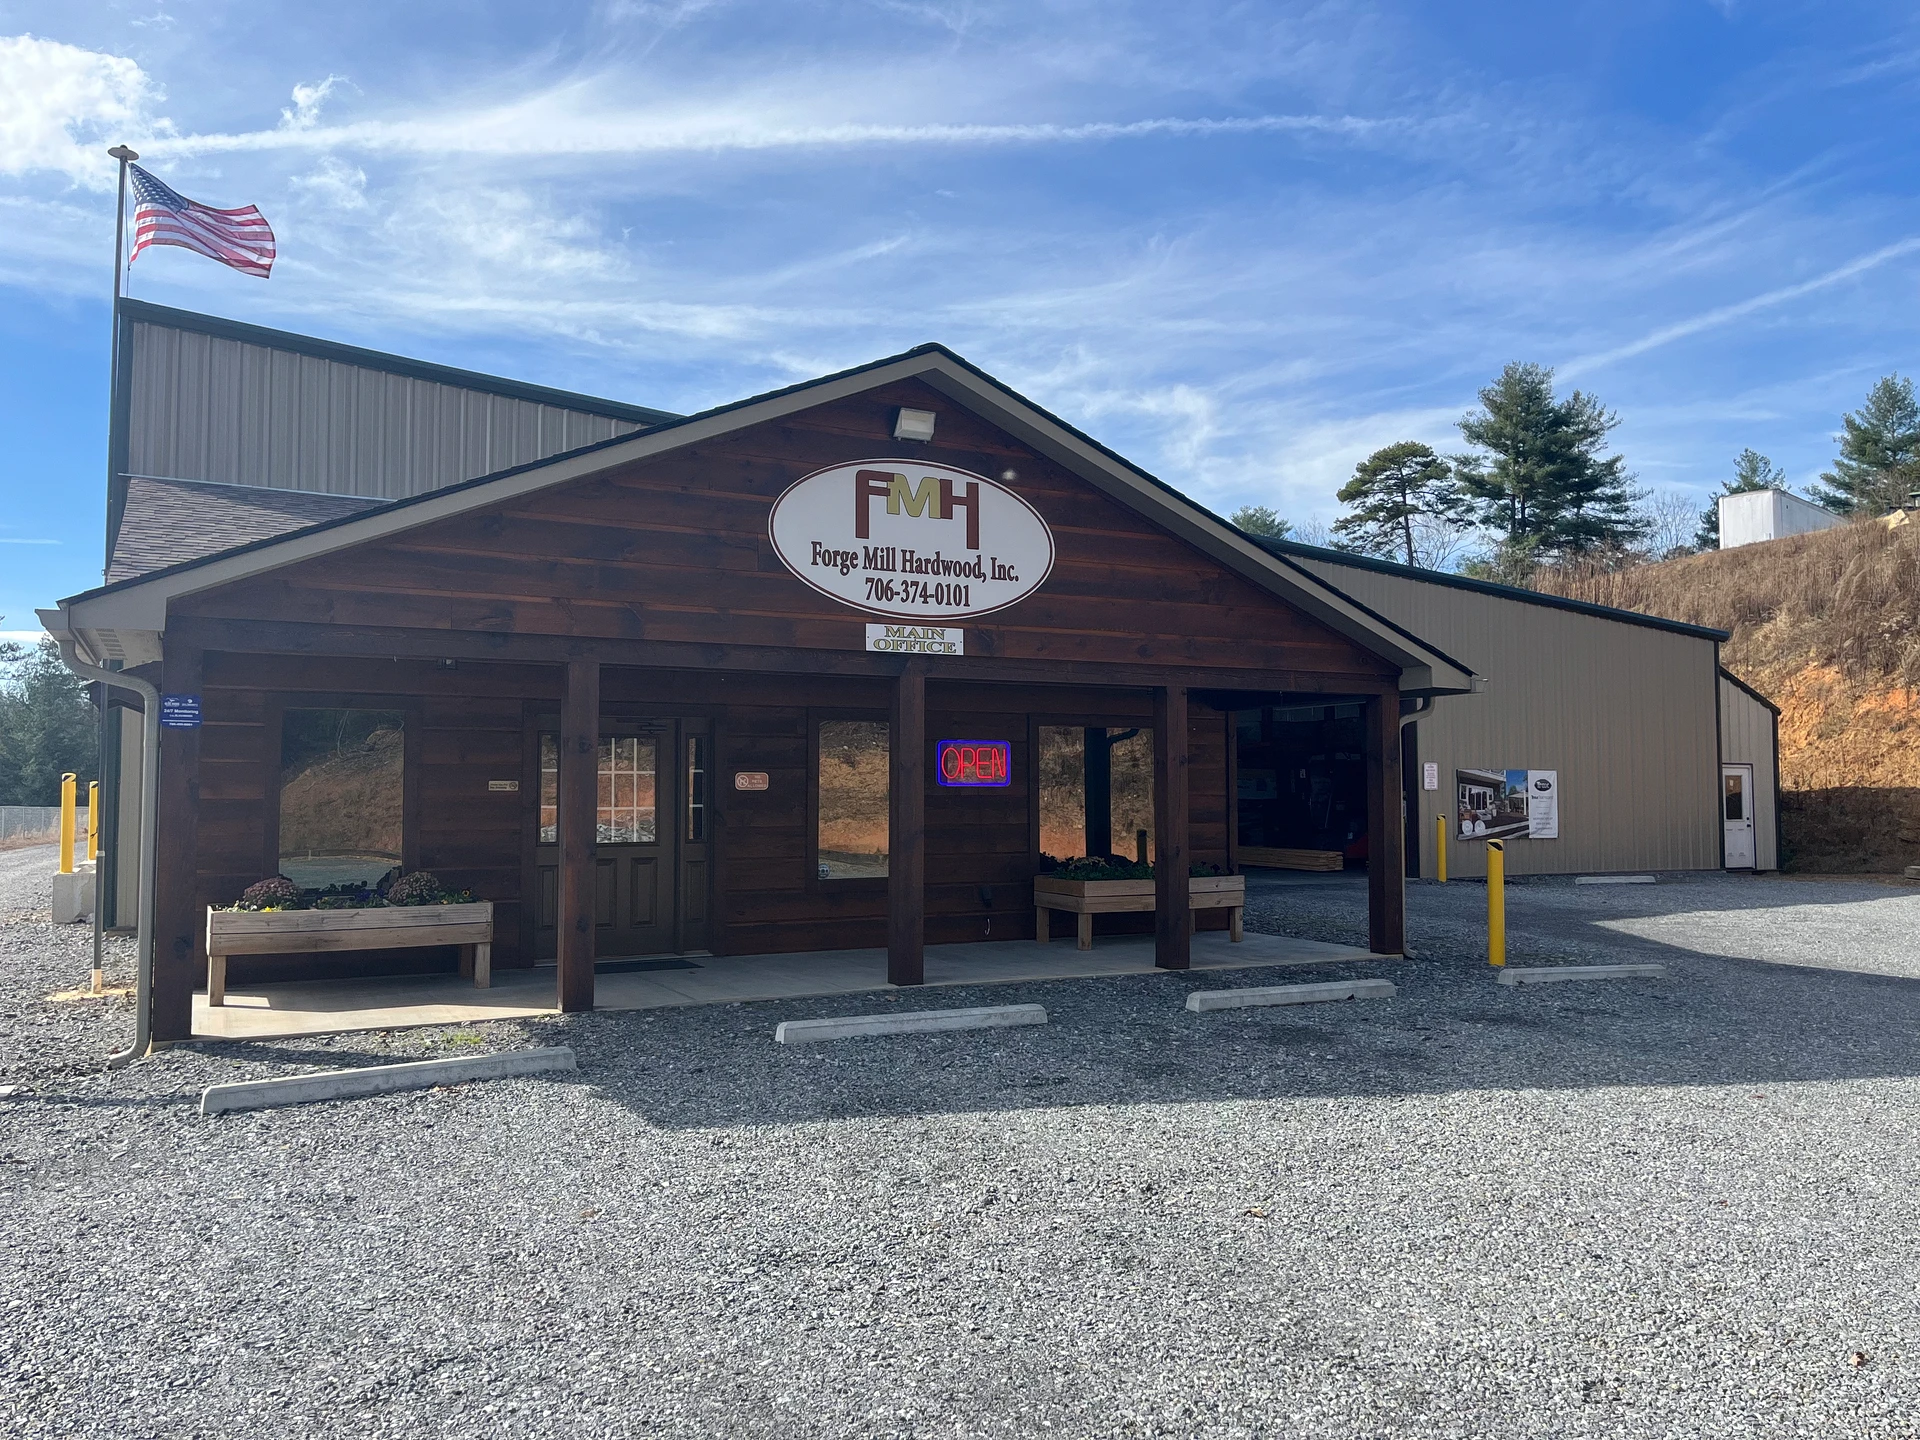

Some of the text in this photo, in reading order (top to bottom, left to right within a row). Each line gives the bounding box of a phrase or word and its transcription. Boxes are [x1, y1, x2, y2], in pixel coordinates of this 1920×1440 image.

[855, 469, 979, 550] FMH
[811, 541, 1019, 583] Forge Mill Hardwood, Inc.
[865, 577, 971, 607] 706-374-0101
[873, 639, 957, 654] OFFICE
[884, 626, 946, 640] MAIN
[941, 747, 1007, 779] OPEN
